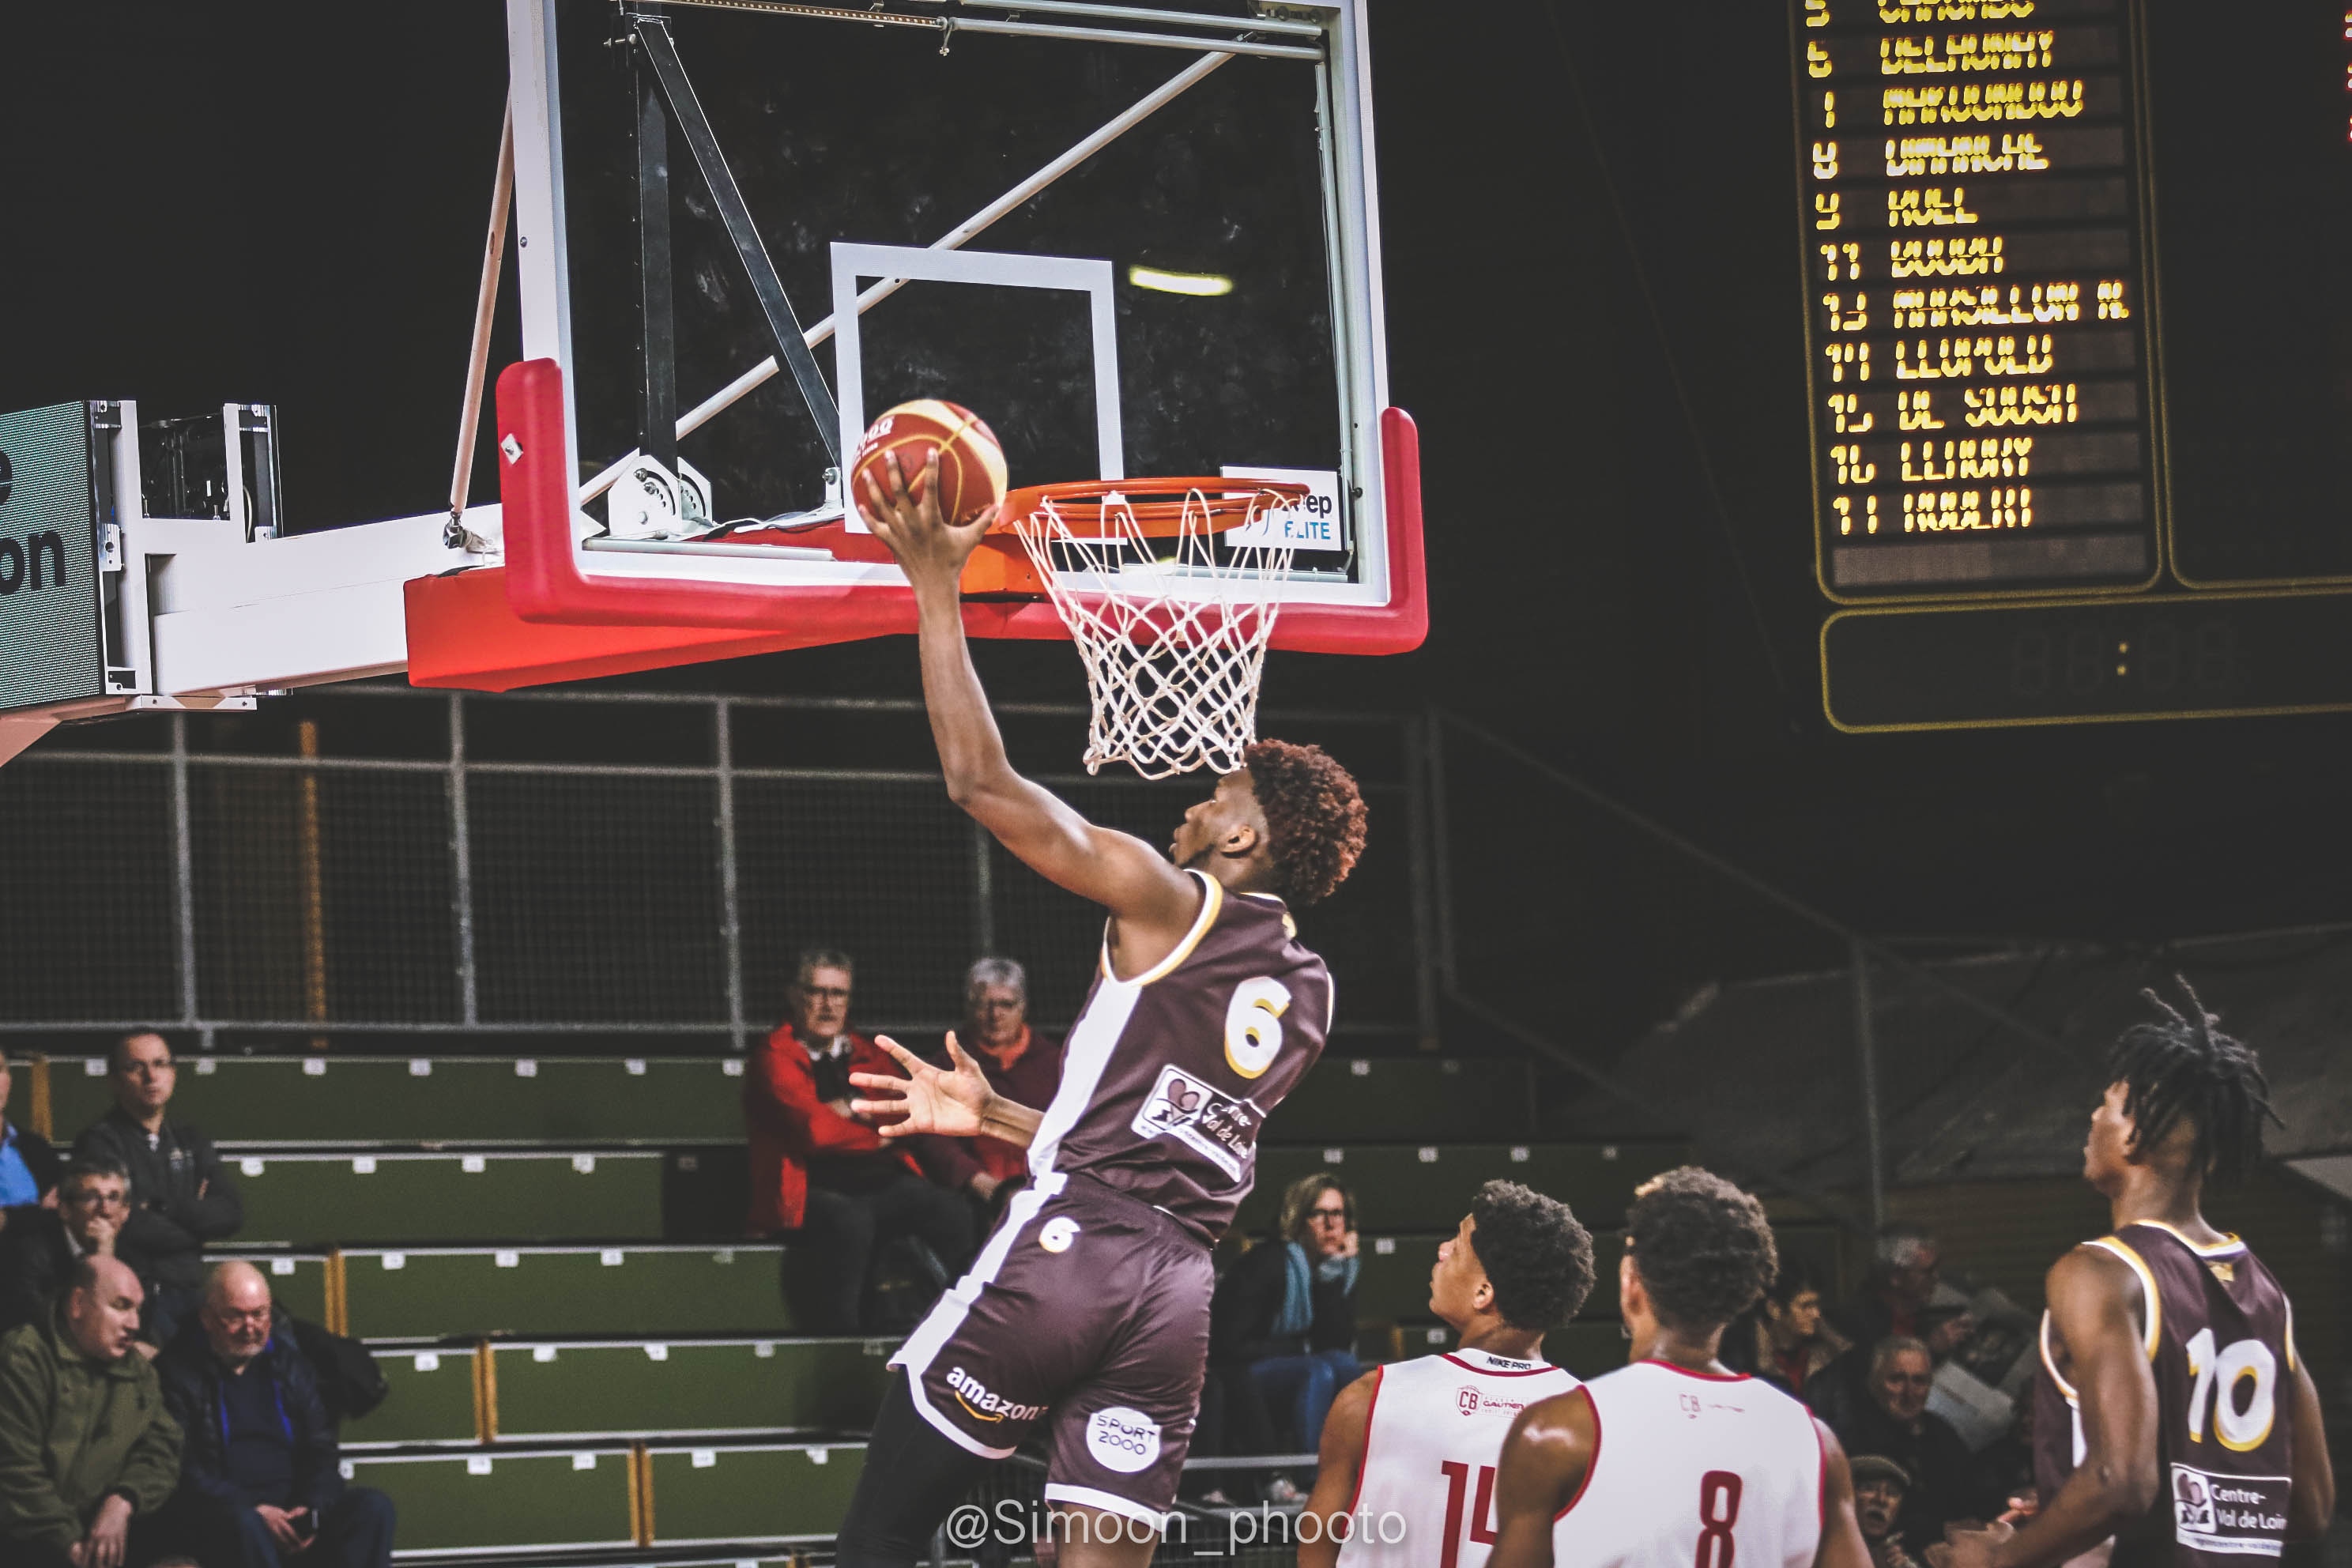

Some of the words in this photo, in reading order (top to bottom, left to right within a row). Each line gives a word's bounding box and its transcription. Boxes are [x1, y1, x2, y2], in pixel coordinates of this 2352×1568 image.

[1224, 976, 1291, 1079] 6
[1039, 1216, 1080, 1253] 6
[1487, 1356, 1510, 1369] NIKE
[1510, 1359, 1532, 1370] PRO
[1459, 1391, 1479, 1410] CB
[2186, 1328, 2275, 1453] 10
[1096, 1415, 1155, 1443] SPORT
[1099, 1430, 1146, 1455] 2000
[1694, 1470, 1743, 1568] 8
[2215, 1508, 2237, 1528] Val
[2237, 1510, 2258, 1528] de
